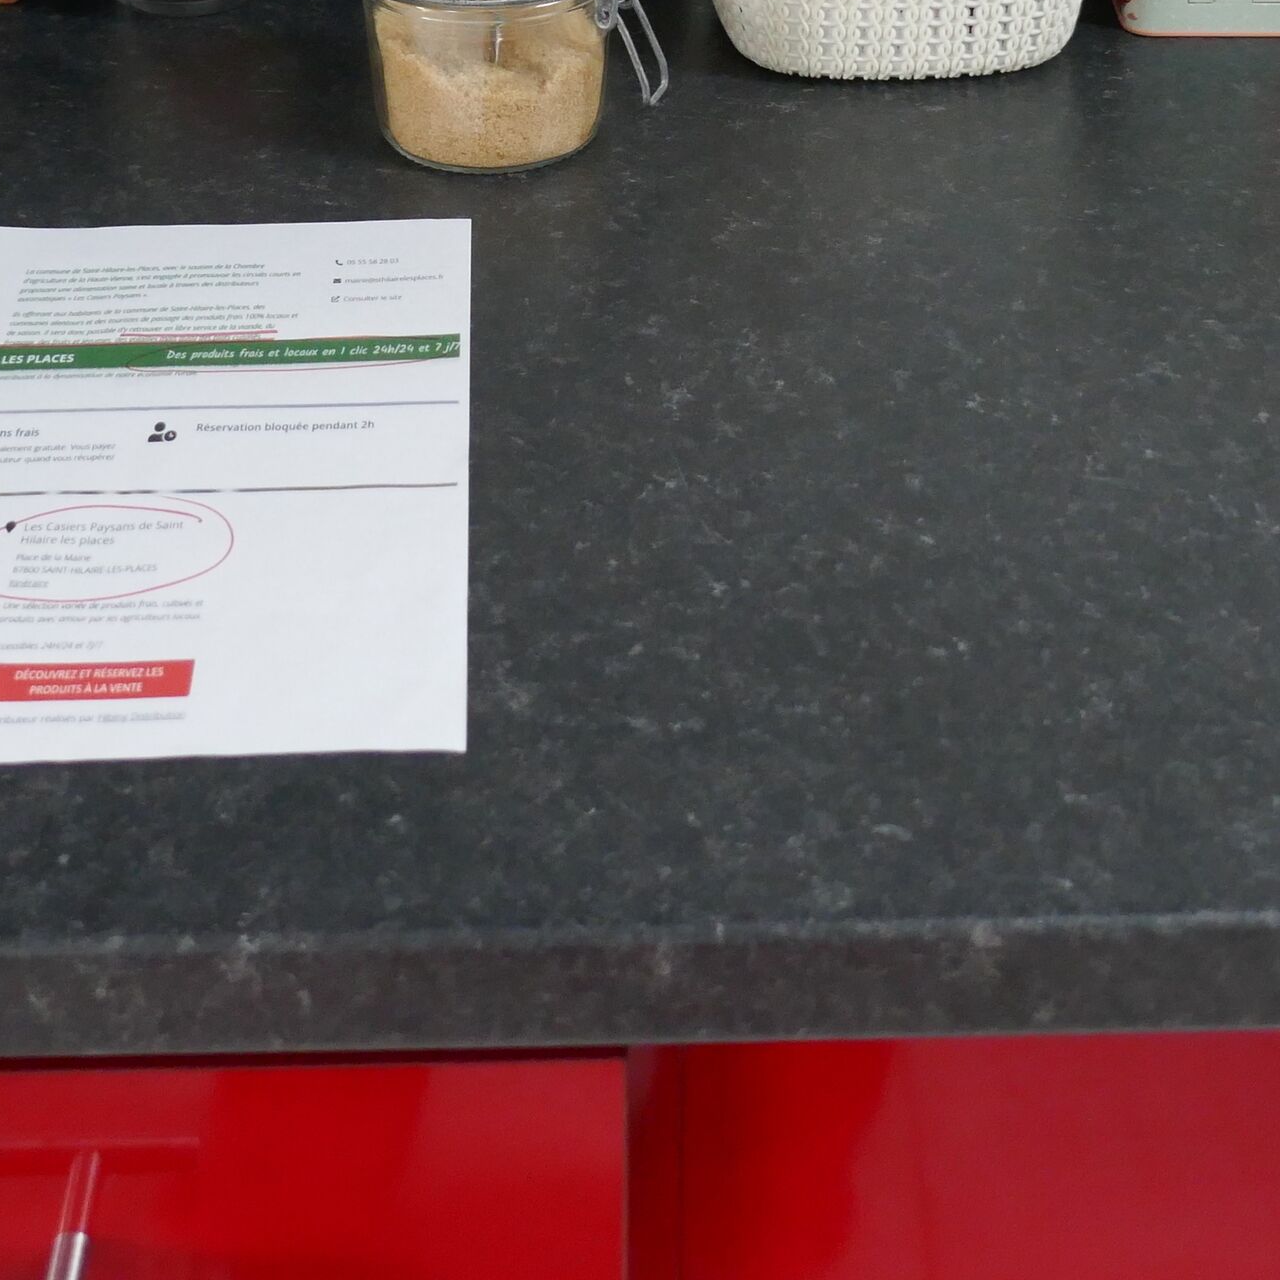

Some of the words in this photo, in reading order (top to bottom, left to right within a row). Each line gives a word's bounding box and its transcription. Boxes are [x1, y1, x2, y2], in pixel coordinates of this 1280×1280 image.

[166, 349, 186, 359] Des
[190, 348, 234, 361] produits
[239, 347, 264, 357] frais
[268, 346, 280, 356] et
[284, 345, 318, 356] locaux
[321, 347, 336, 355] en
[349, 344, 368, 354] clic
[373, 342, 414, 353] 24h/24
[418, 342, 430, 352] et
[0, 355, 23, 365] LES
[26, 354, 74, 365] PLACES
[14, 428, 39, 437] frais
[196, 422, 261, 432] Réservation
[264, 421, 308, 433] bloquée
[311, 420, 357, 432] pendant
[361, 420, 374, 429] 2h
[24, 522, 43, 532] Les
[45, 521, 87, 531] Casiers
[89, 520, 135, 533] Paysans
[138, 520, 152, 530] de
[155, 520, 183, 530] Saint
[20, 535, 57, 545] Hilaire
[60, 535, 76, 545] les
[78, 535, 114, 547] places
[14, 669, 77, 680] DÉCOUVREZ
[78, 668, 90, 678] ET
[93, 667, 143, 678] RÉSERVEZ
[145, 667, 164, 677] LES
[29, 683, 82, 694] PRODUITS
[83, 683, 92, 693] À
[93, 683, 107, 693] LA
[108, 682, 142, 692] VENTE
